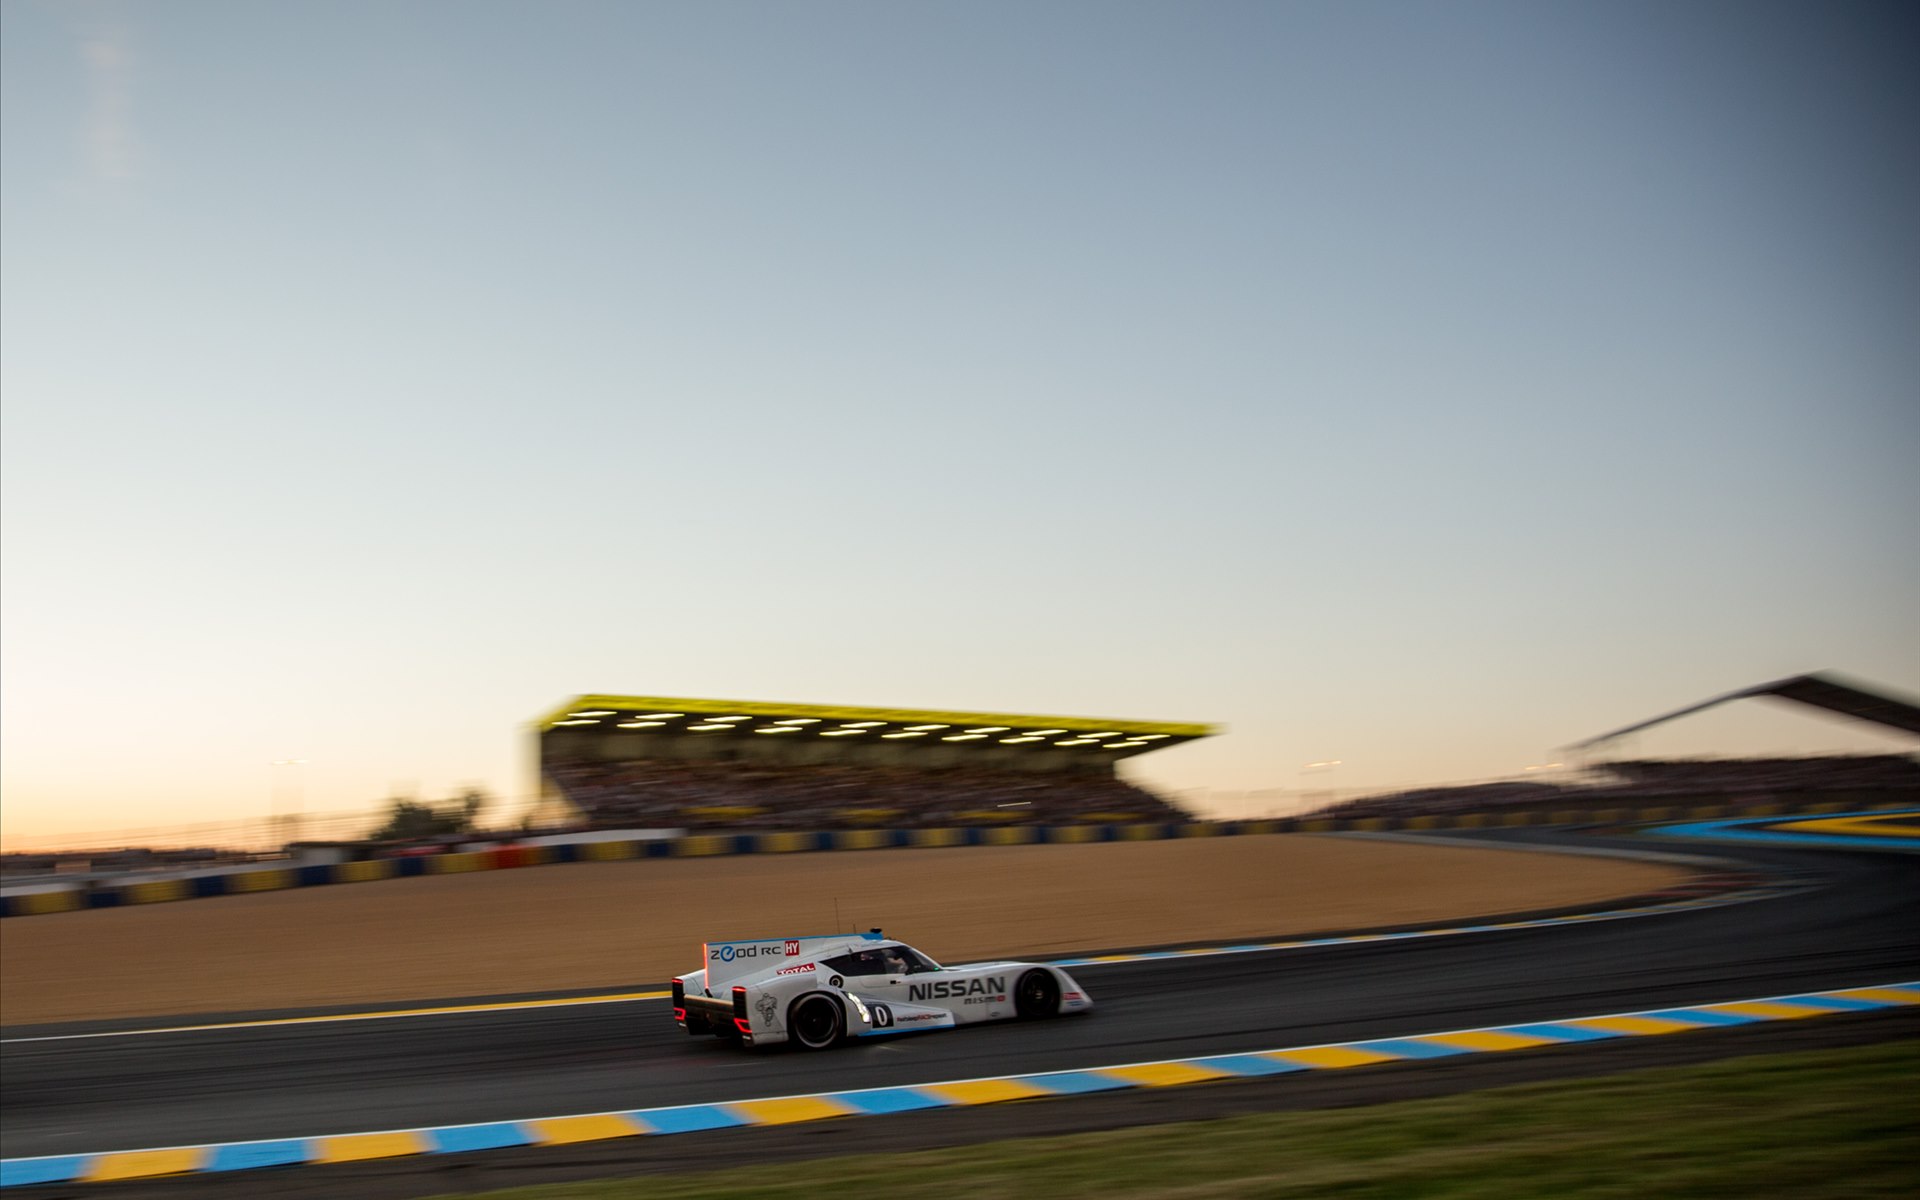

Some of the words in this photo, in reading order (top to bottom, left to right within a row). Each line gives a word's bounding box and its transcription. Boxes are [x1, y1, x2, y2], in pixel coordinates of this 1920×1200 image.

[761, 946, 782, 955] RC
[785, 941, 799, 954] HY
[778, 964, 815, 975] TOTAL
[909, 977, 1005, 1001] NISSAN
[875, 1006, 888, 1026] 0
